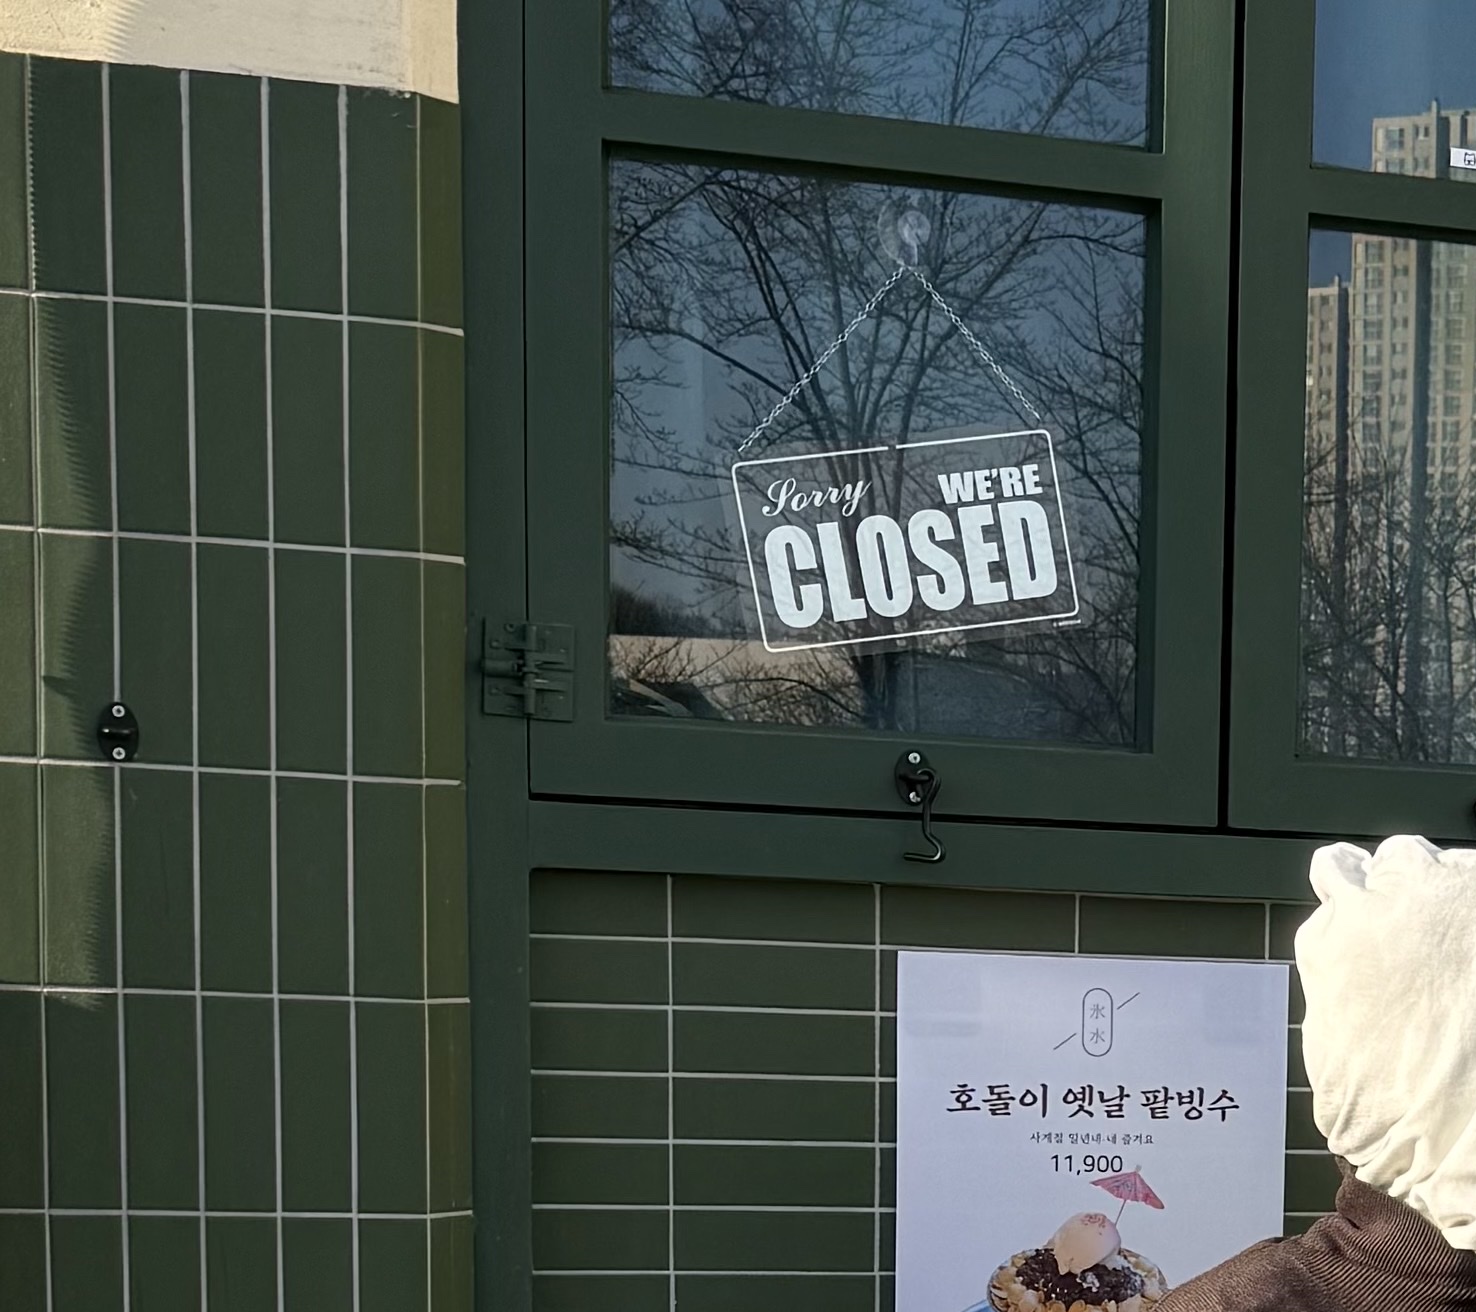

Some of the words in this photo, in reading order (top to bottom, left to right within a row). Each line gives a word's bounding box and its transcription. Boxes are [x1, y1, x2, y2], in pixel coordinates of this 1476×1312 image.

[761, 477, 872, 518] Sorry
[937, 464, 1044, 505] WE'RE
[764, 499, 1058, 629] CLOSED
[946, 1082, 1049, 1118] 호돌이
[1061, 1084, 1132, 1119] 옛날
[1139, 1086, 1241, 1122] 팥빙수
[1050, 1154, 1124, 1176] 11,900
